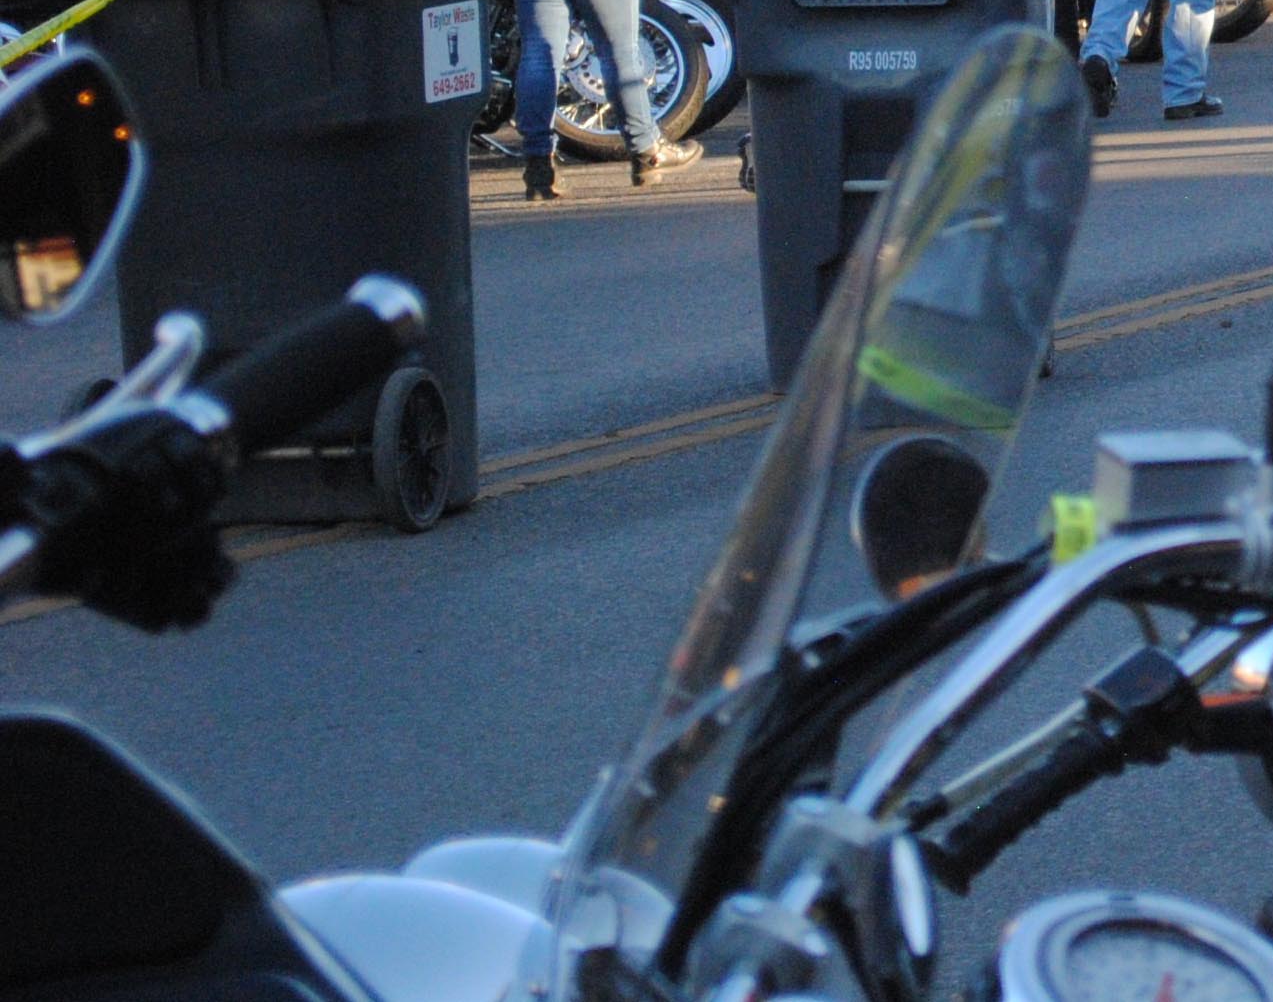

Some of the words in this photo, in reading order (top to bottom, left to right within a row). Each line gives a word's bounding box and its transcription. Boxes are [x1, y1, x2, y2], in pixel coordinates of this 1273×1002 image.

[427, 10, 452, 31] Taylor
[453, 6, 476, 24] Waste
[848, 51, 872, 71] R95
[874, 50, 917, 71] 005759
